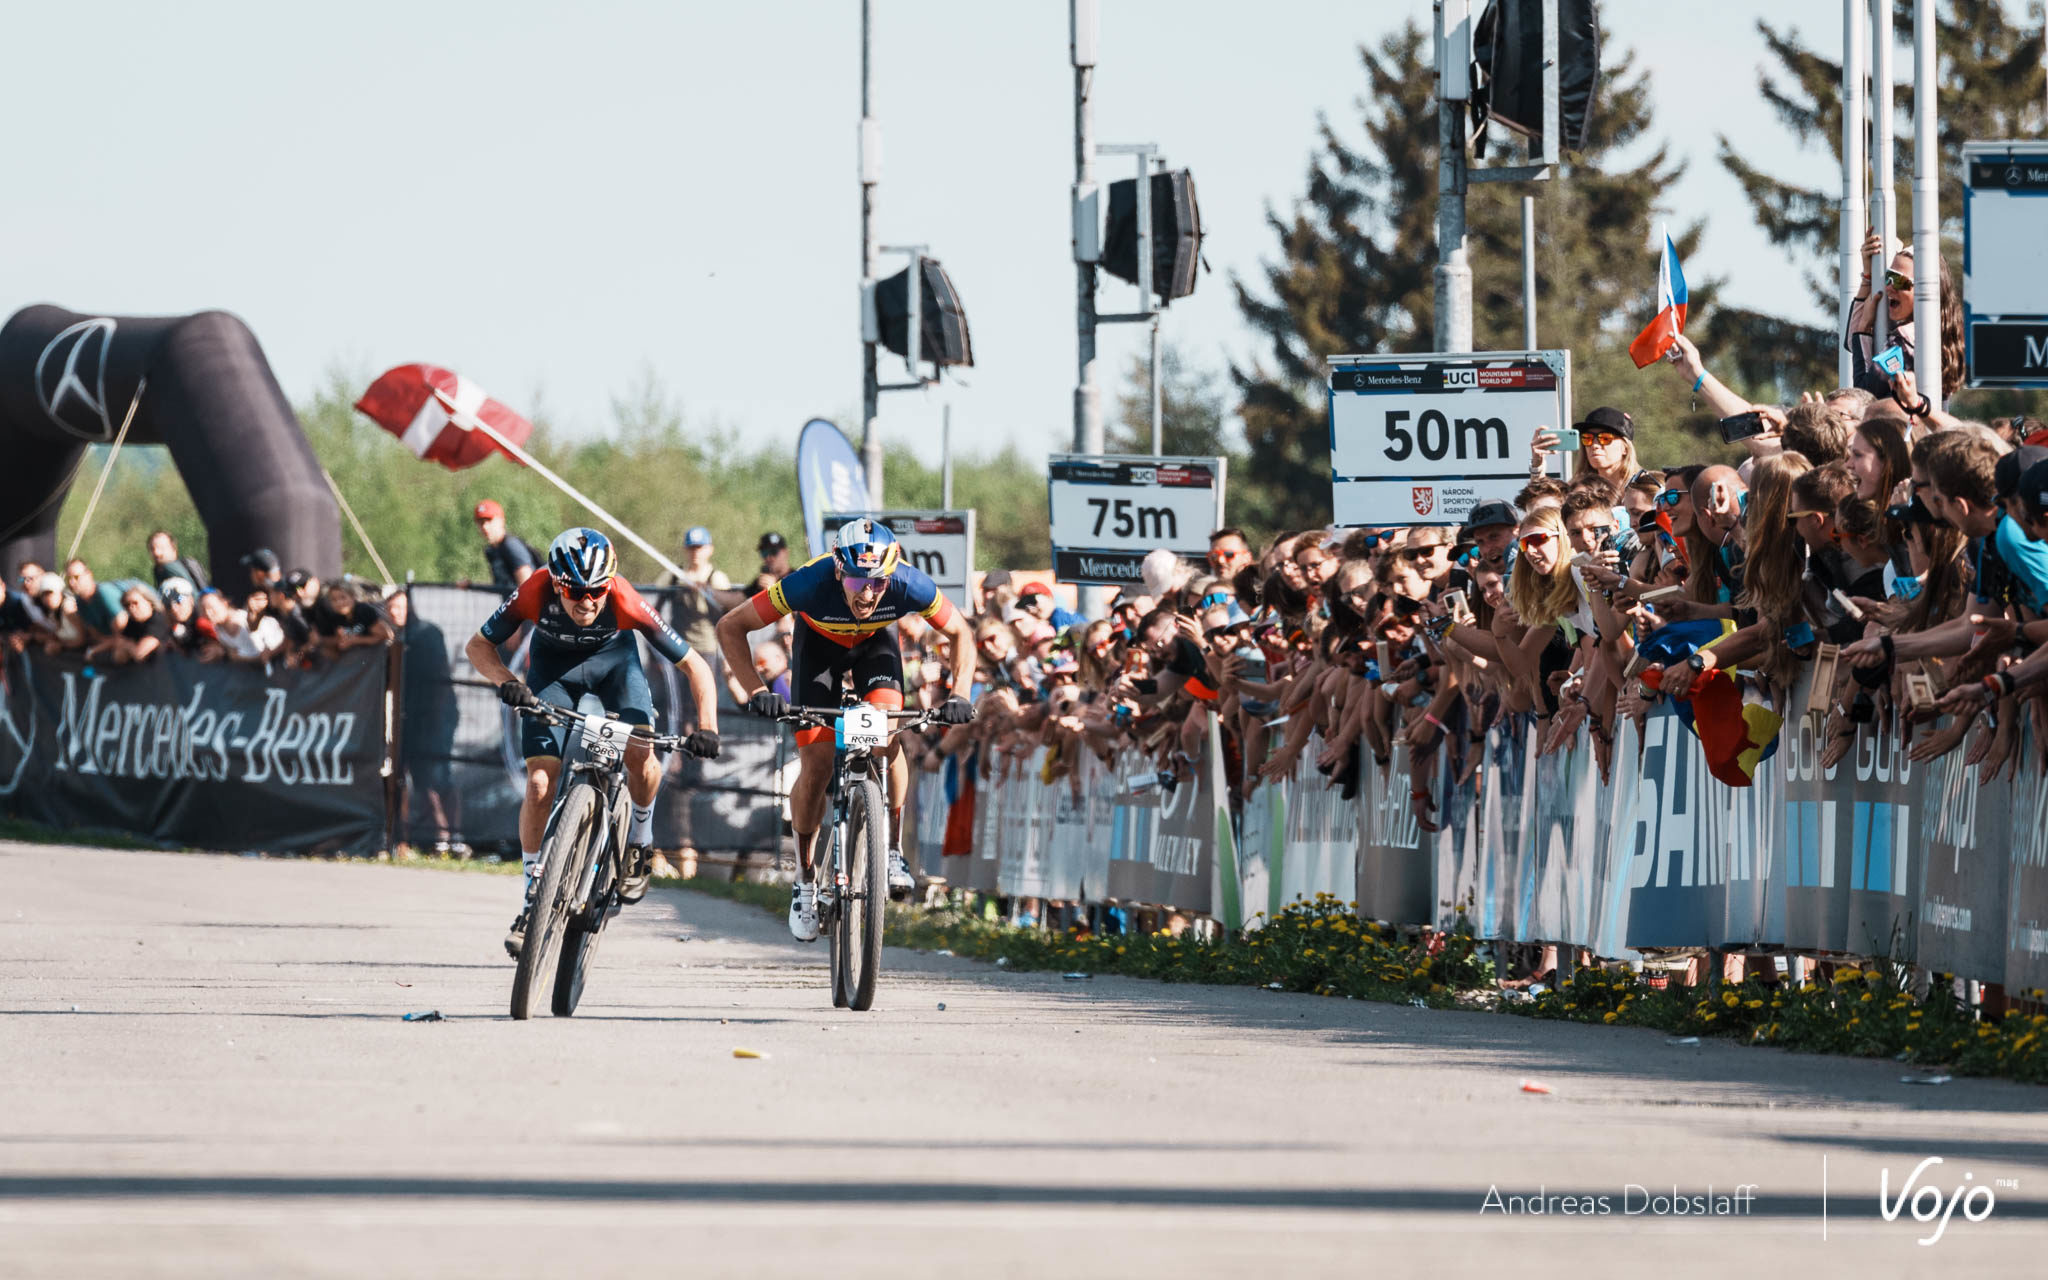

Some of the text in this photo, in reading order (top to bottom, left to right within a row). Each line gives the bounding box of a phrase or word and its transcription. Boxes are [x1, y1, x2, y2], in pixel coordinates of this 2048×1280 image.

[1367, 375, 1422, 385] Mercedes-Benz
[1448, 371, 1476, 385] UCI
[1479, 370, 1510, 378] MOUNTAIN
[1383, 409, 1509, 461] 50m
[1088, 498, 1177, 539] 75m
[55, 672, 357, 786] Mercedes-Benz
[861, 713, 873, 729] 5
[599, 721, 614, 740] 6
